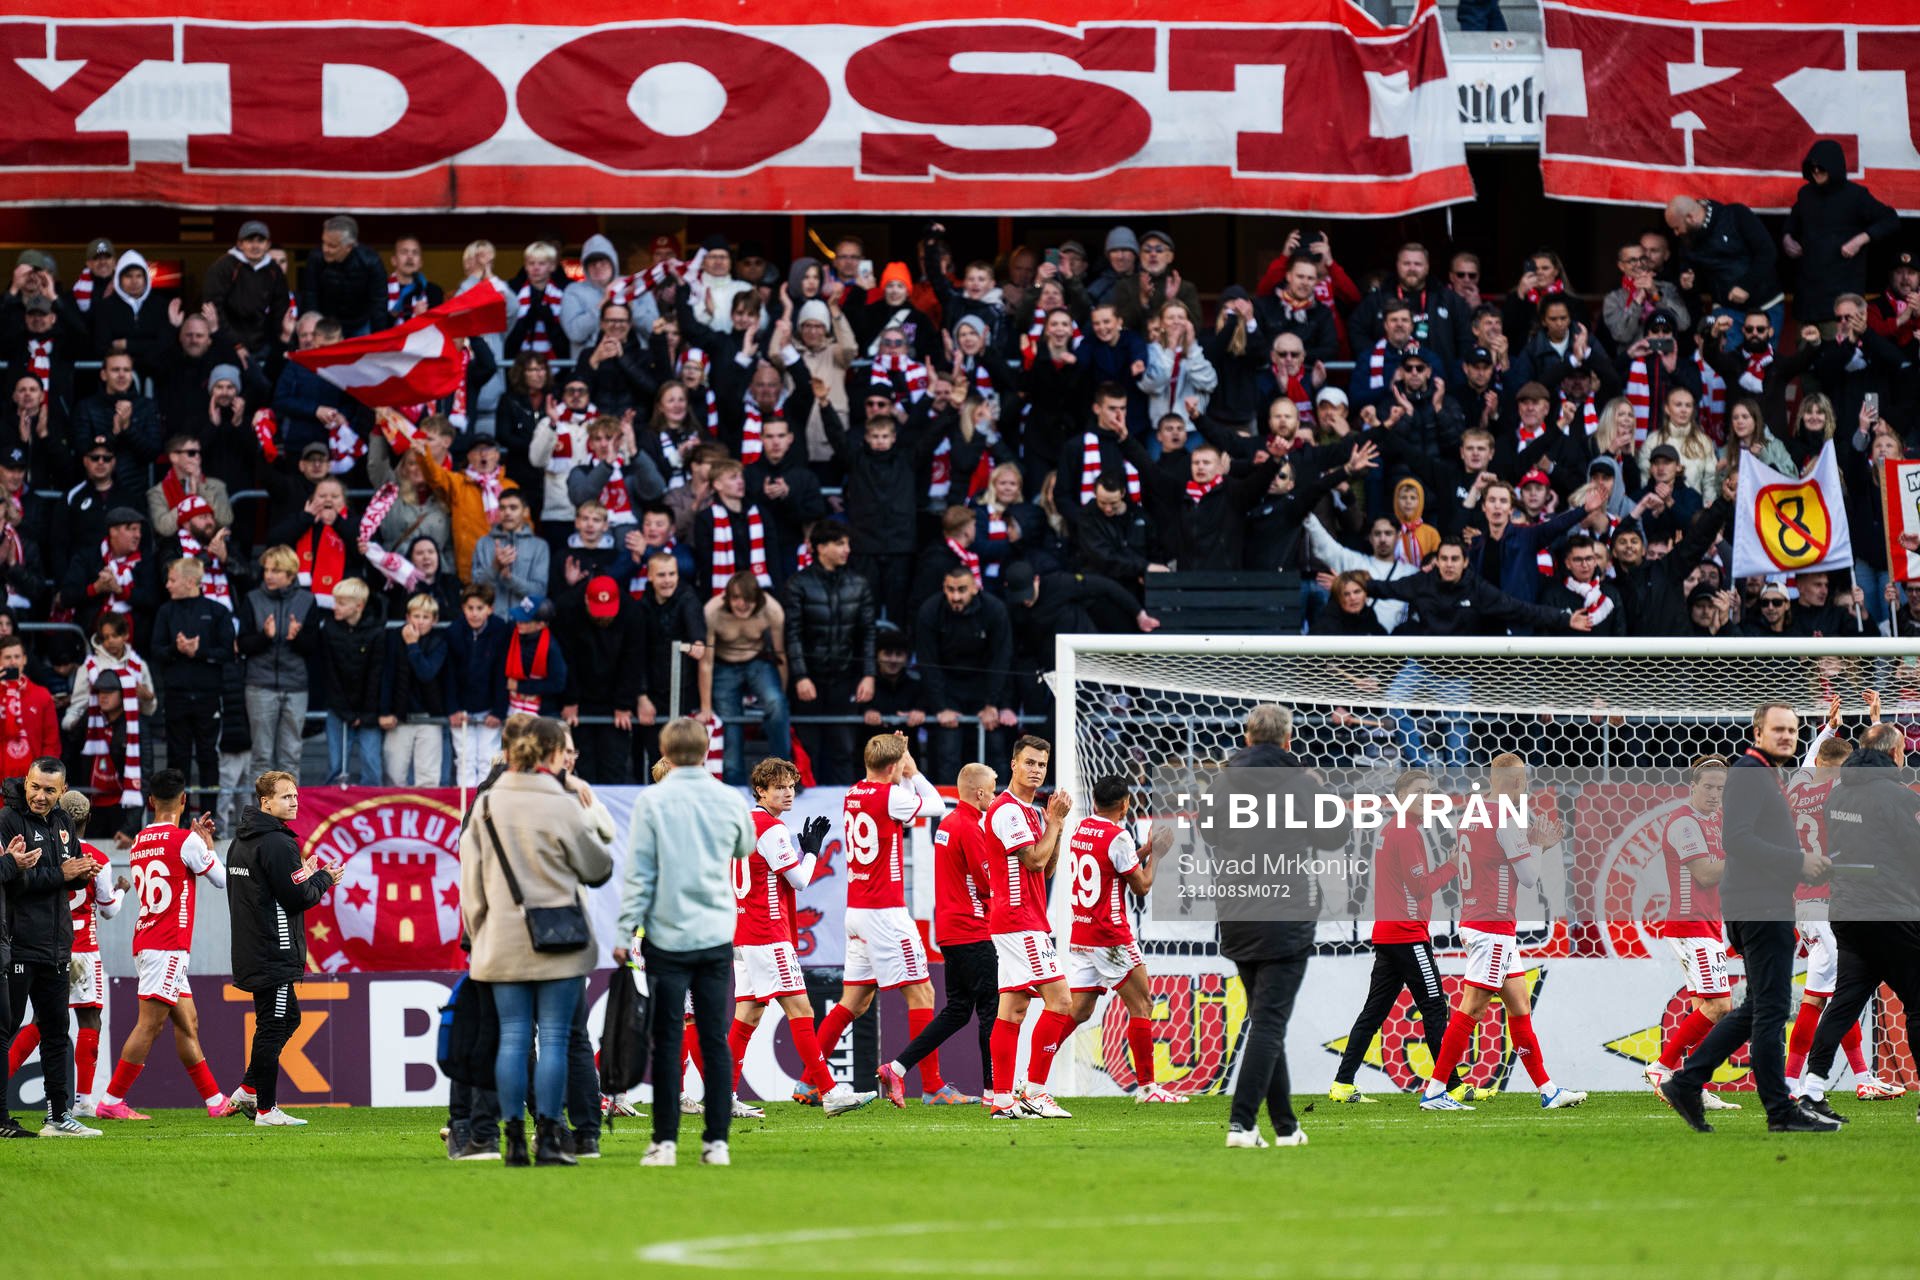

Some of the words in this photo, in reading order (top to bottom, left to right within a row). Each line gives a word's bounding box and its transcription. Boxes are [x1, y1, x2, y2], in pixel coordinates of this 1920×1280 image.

[1830, 809, 1863, 824] YASKAWA
[139, 832, 170, 844] REDEYE
[844, 810, 879, 865] 39
[1080, 826, 1105, 838] REDEYE
[131, 860, 172, 917] 26
[14, 964, 24, 973] EN
[1049, 962, 1057, 973] 5
[1719, 976, 1727, 987] 13
